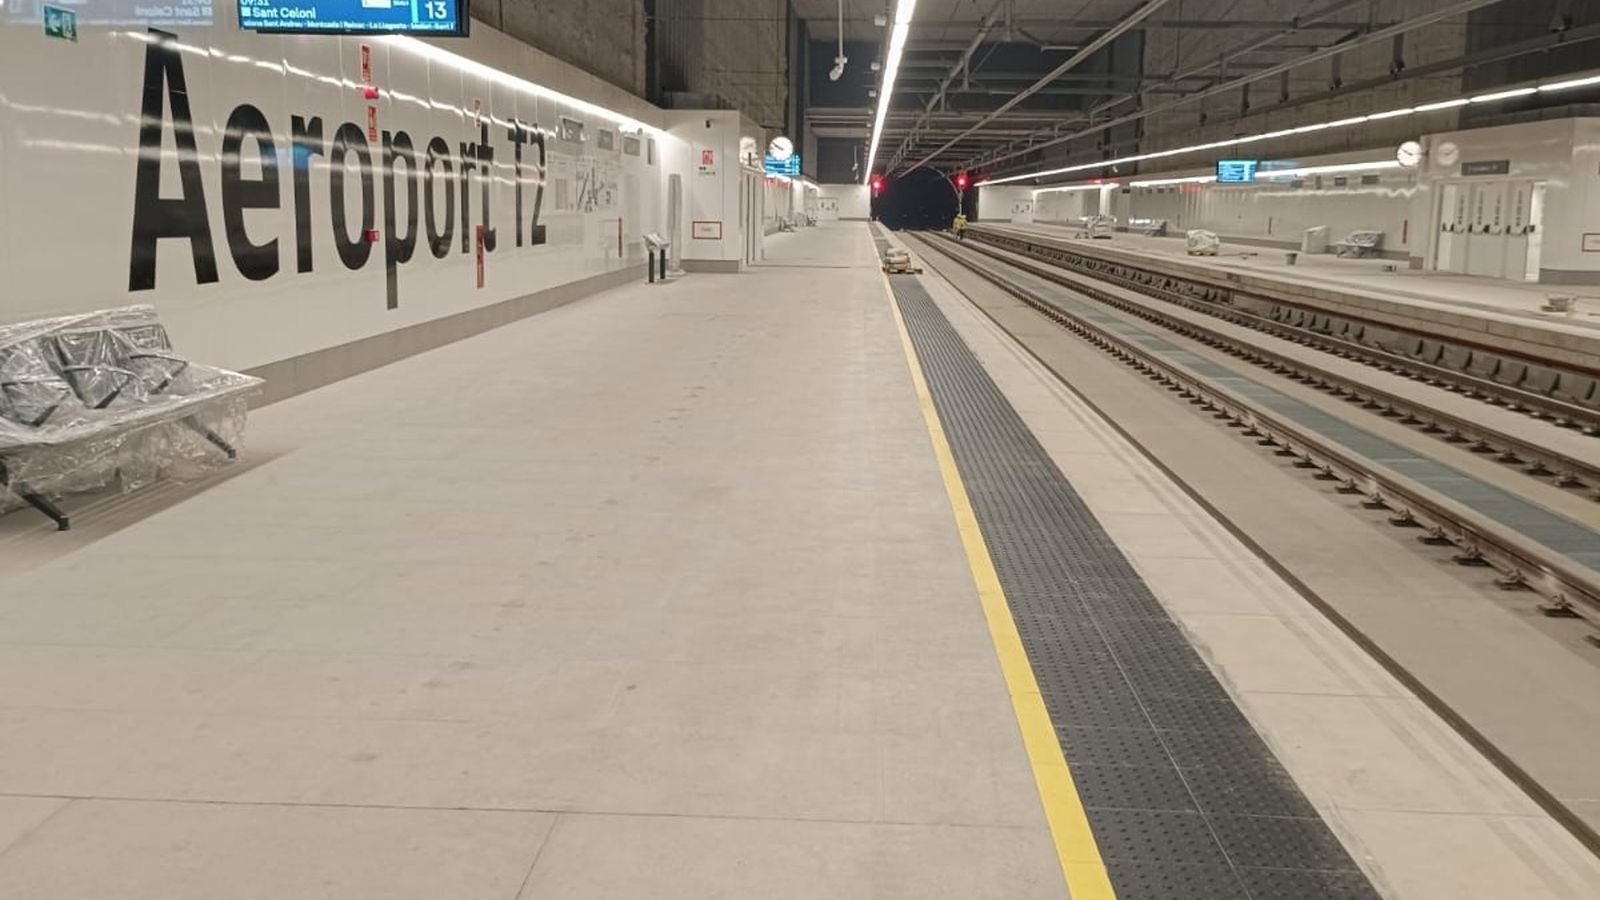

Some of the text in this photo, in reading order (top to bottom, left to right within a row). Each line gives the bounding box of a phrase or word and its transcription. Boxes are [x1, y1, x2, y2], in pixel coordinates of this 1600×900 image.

[253, 7, 316, 19] Sant Celoni
[424, 1, 447, 19] 13
[128, 28, 546, 310] Aeroport T2
